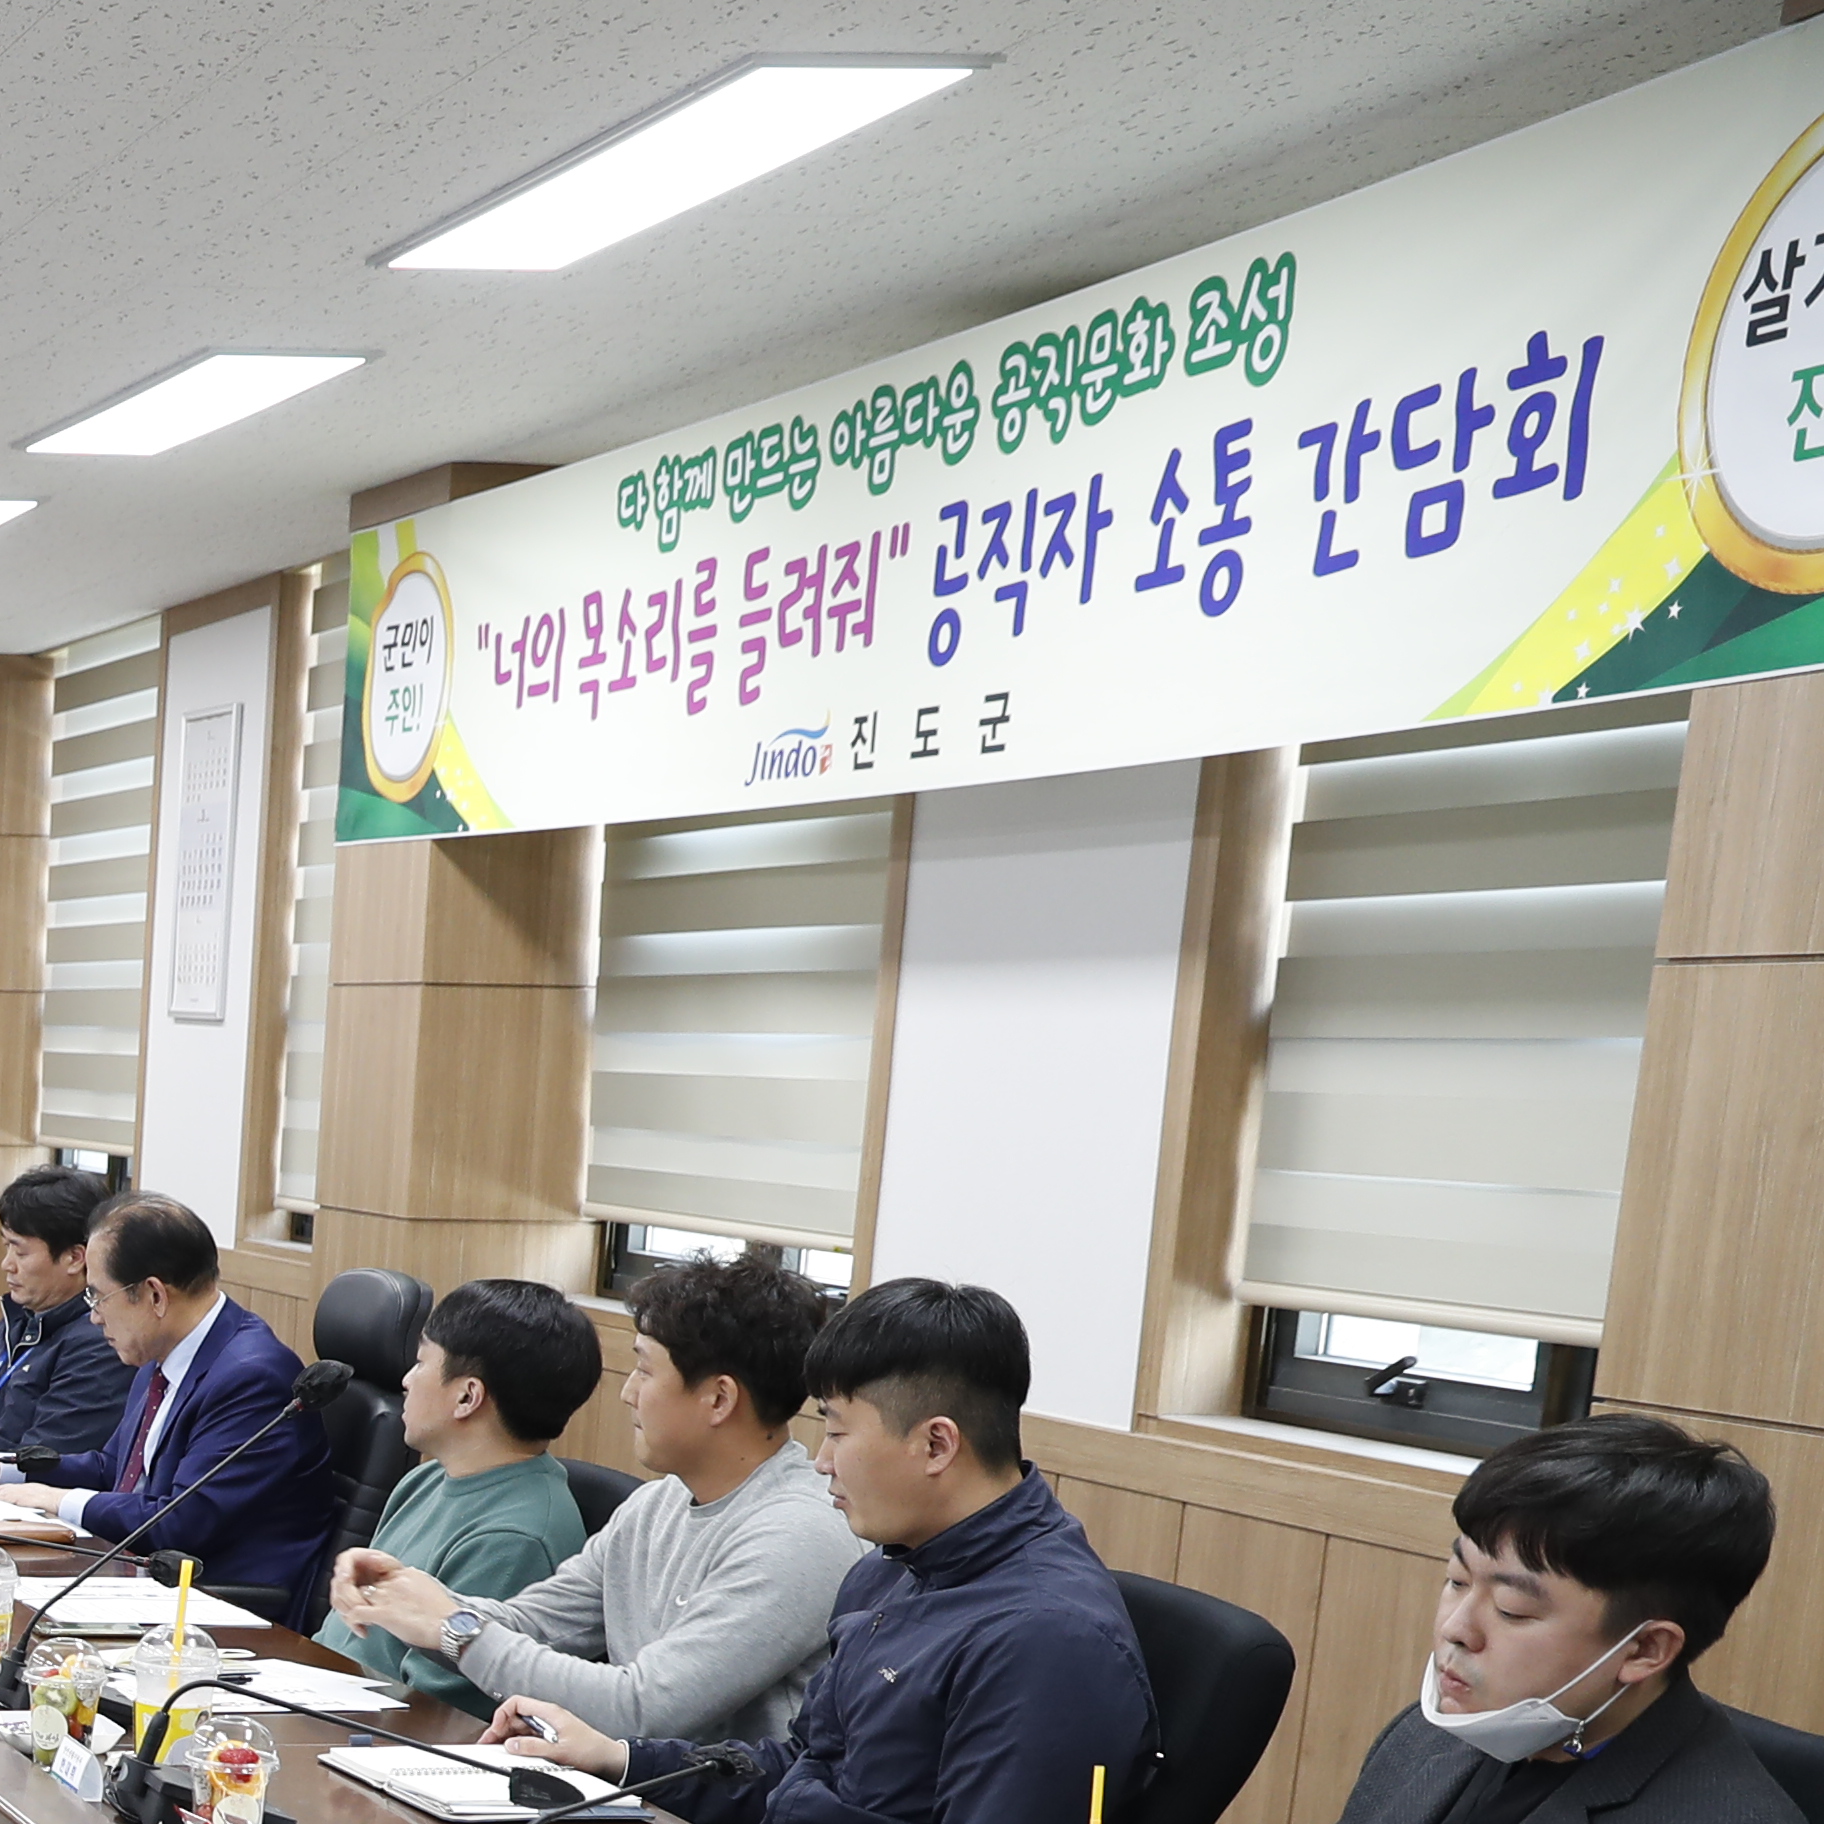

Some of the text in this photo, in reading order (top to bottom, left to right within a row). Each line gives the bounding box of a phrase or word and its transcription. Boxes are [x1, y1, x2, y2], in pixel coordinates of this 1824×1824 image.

[617, 250, 1297, 553] 다 함께 만드는 아름다운 공직문화 조성
[477, 329, 1606, 721] "너의 목소리를 들려줘" 공직자 소통 간담회
[382, 615, 435, 672] 군민이
[384, 683, 424, 737] 주인!
[744, 739, 818, 787] Jindo
